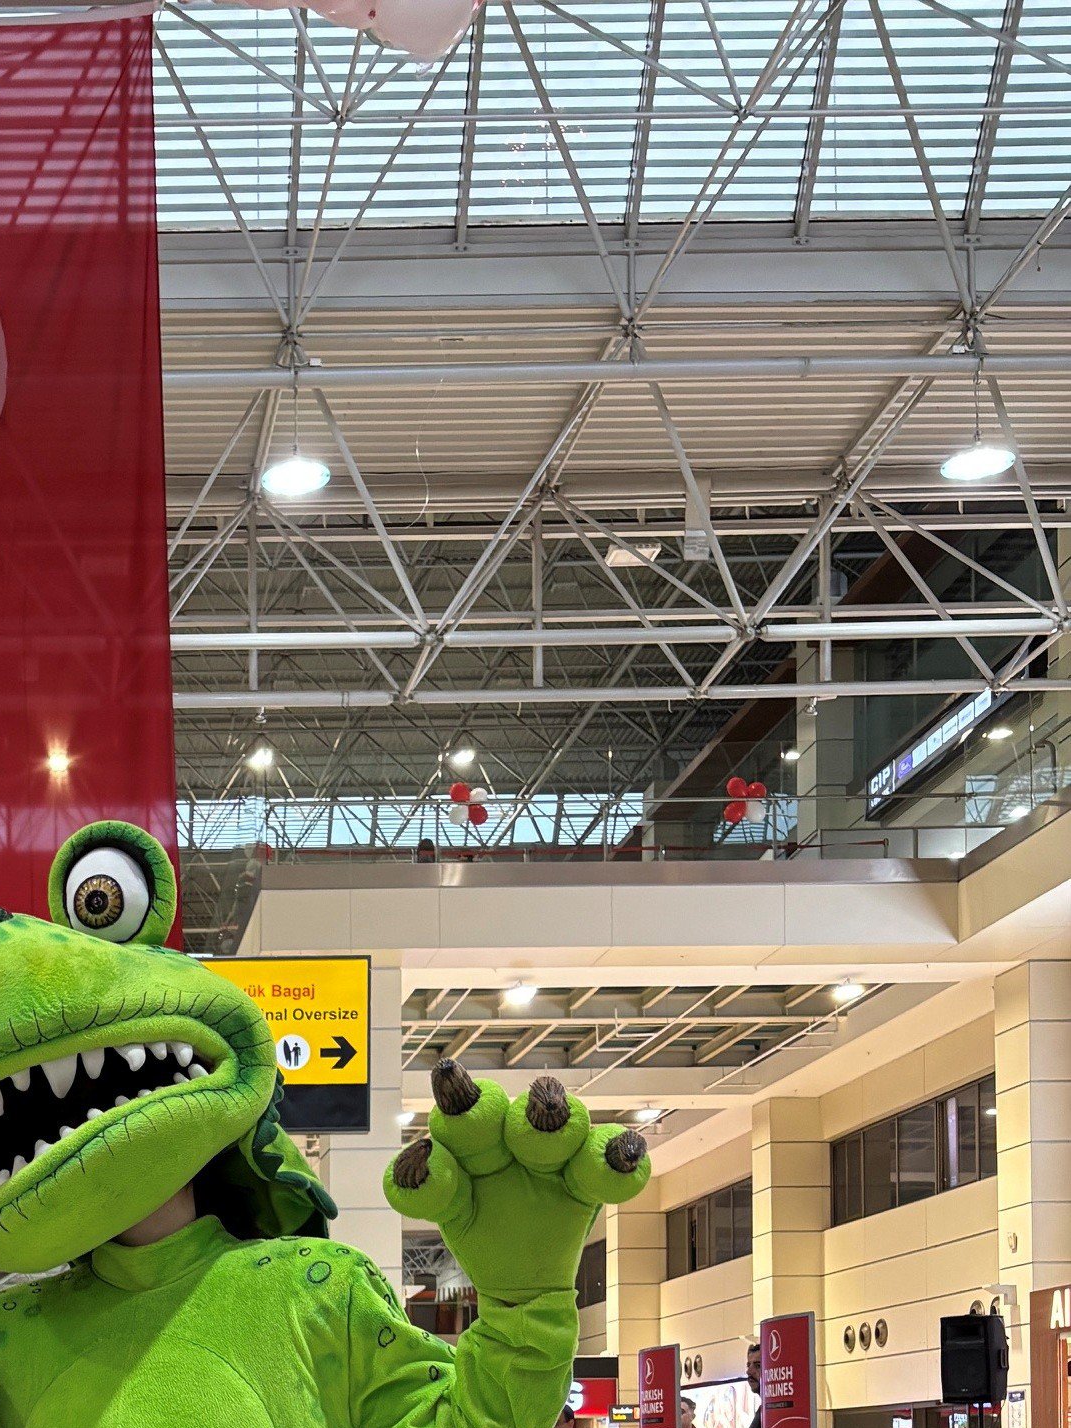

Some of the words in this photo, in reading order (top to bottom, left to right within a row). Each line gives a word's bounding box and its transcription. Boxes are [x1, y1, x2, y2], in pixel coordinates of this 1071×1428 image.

[870, 766, 891, 795] CIP
[244, 984, 266, 997] ük
[271, 984, 316, 1000] Bagaj
[261, 1008, 288, 1021] nal
[292, 1007, 359, 1021] Oversize
